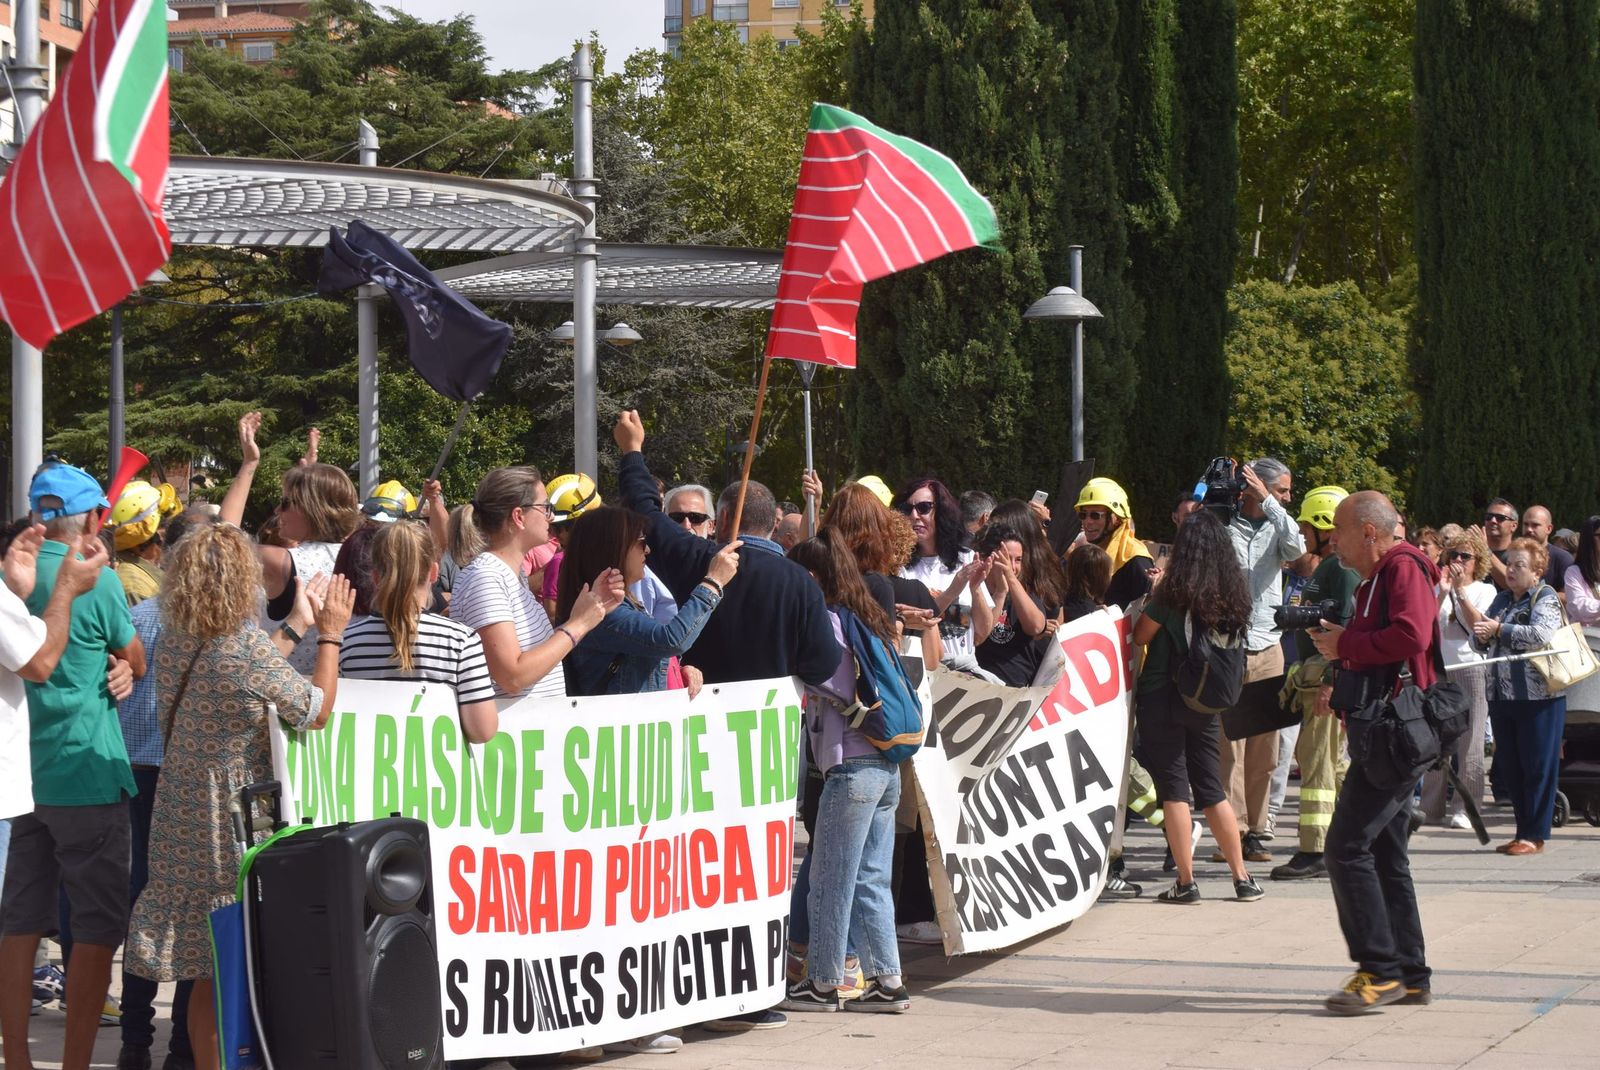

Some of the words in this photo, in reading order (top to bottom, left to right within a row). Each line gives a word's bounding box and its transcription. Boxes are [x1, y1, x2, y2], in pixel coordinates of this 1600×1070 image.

[374, 694, 491, 829] BÁSI
[563, 725, 673, 832] SALUD
[605, 825, 758, 926] PÚBLICA
[445, 958, 468, 1038] S
[483, 951, 604, 1034] RUALES
[617, 940, 667, 1020] SIN
[673, 925, 758, 1006] CITA
